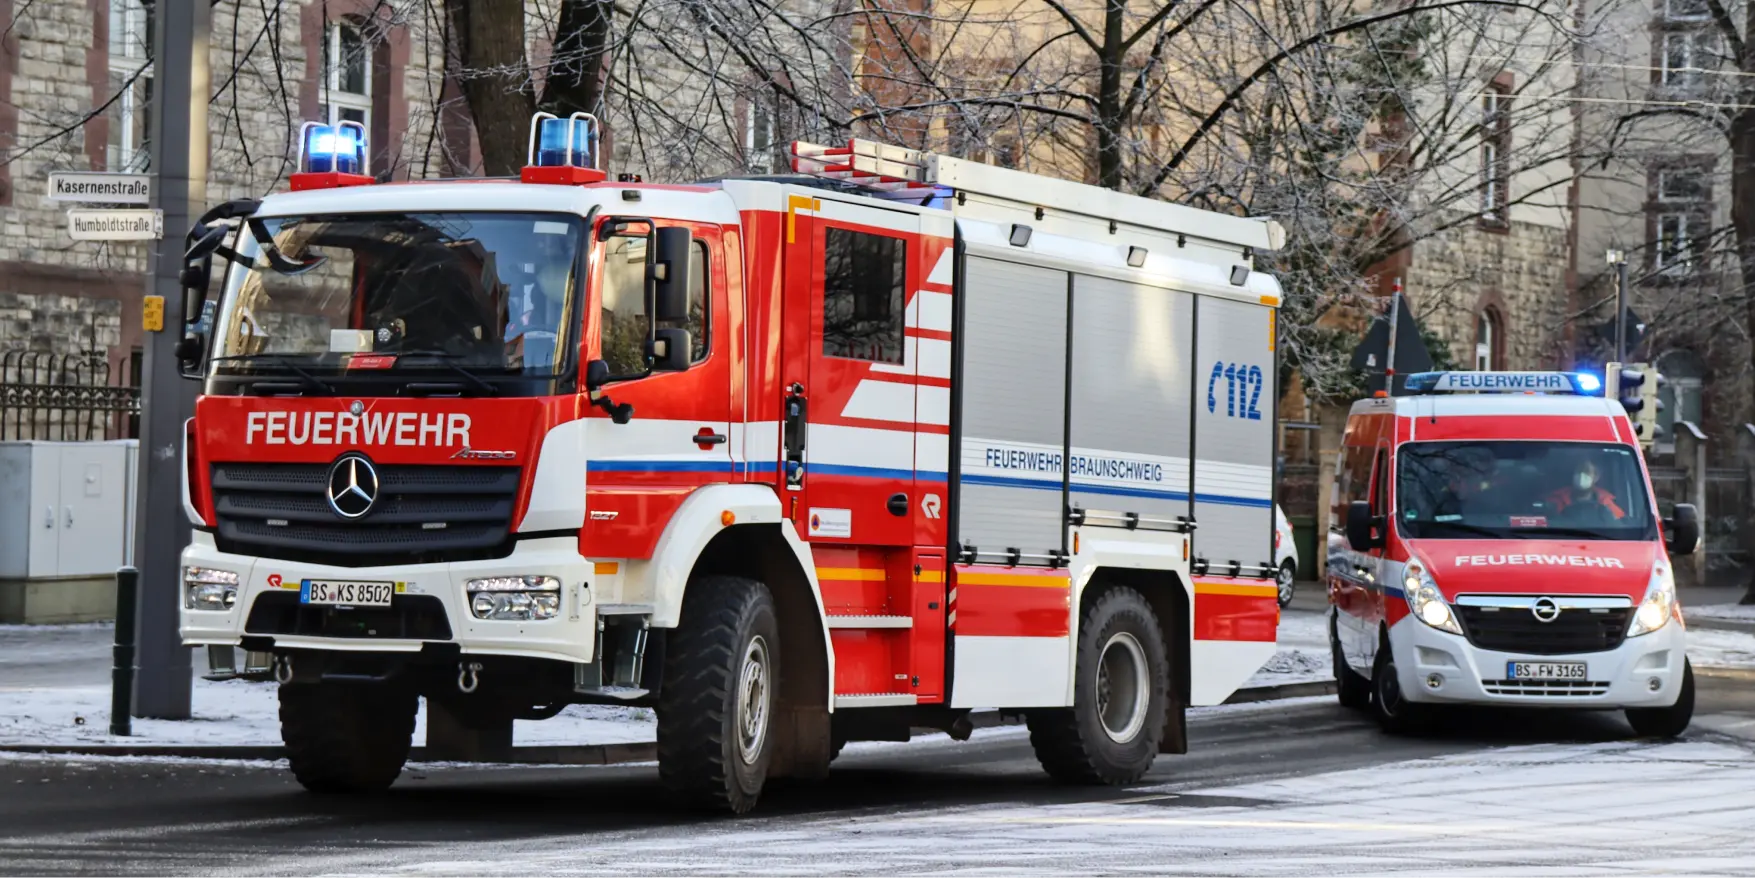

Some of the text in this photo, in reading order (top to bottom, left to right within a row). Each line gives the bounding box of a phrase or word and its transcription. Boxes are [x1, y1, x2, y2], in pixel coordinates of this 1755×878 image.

[57, 178, 148, 196] Kasernenstraße
[75, 217, 150, 232] Humboldtstraße
[1449, 375, 1562, 388] FEUERWEHR
[1224, 362, 1263, 421] 112
[246, 411, 472, 447] FEUERWEHR
[985, 448, 1163, 482] FEUERWEHR BRAUNSCHWEIG
[1454, 553, 1625, 569] FEUERWEHR
[310, 583, 328, 602] BS
[337, 584, 354, 602] KS
[357, 585, 391, 604] 8502
[1516, 664, 1584, 677] BS FW 3165
